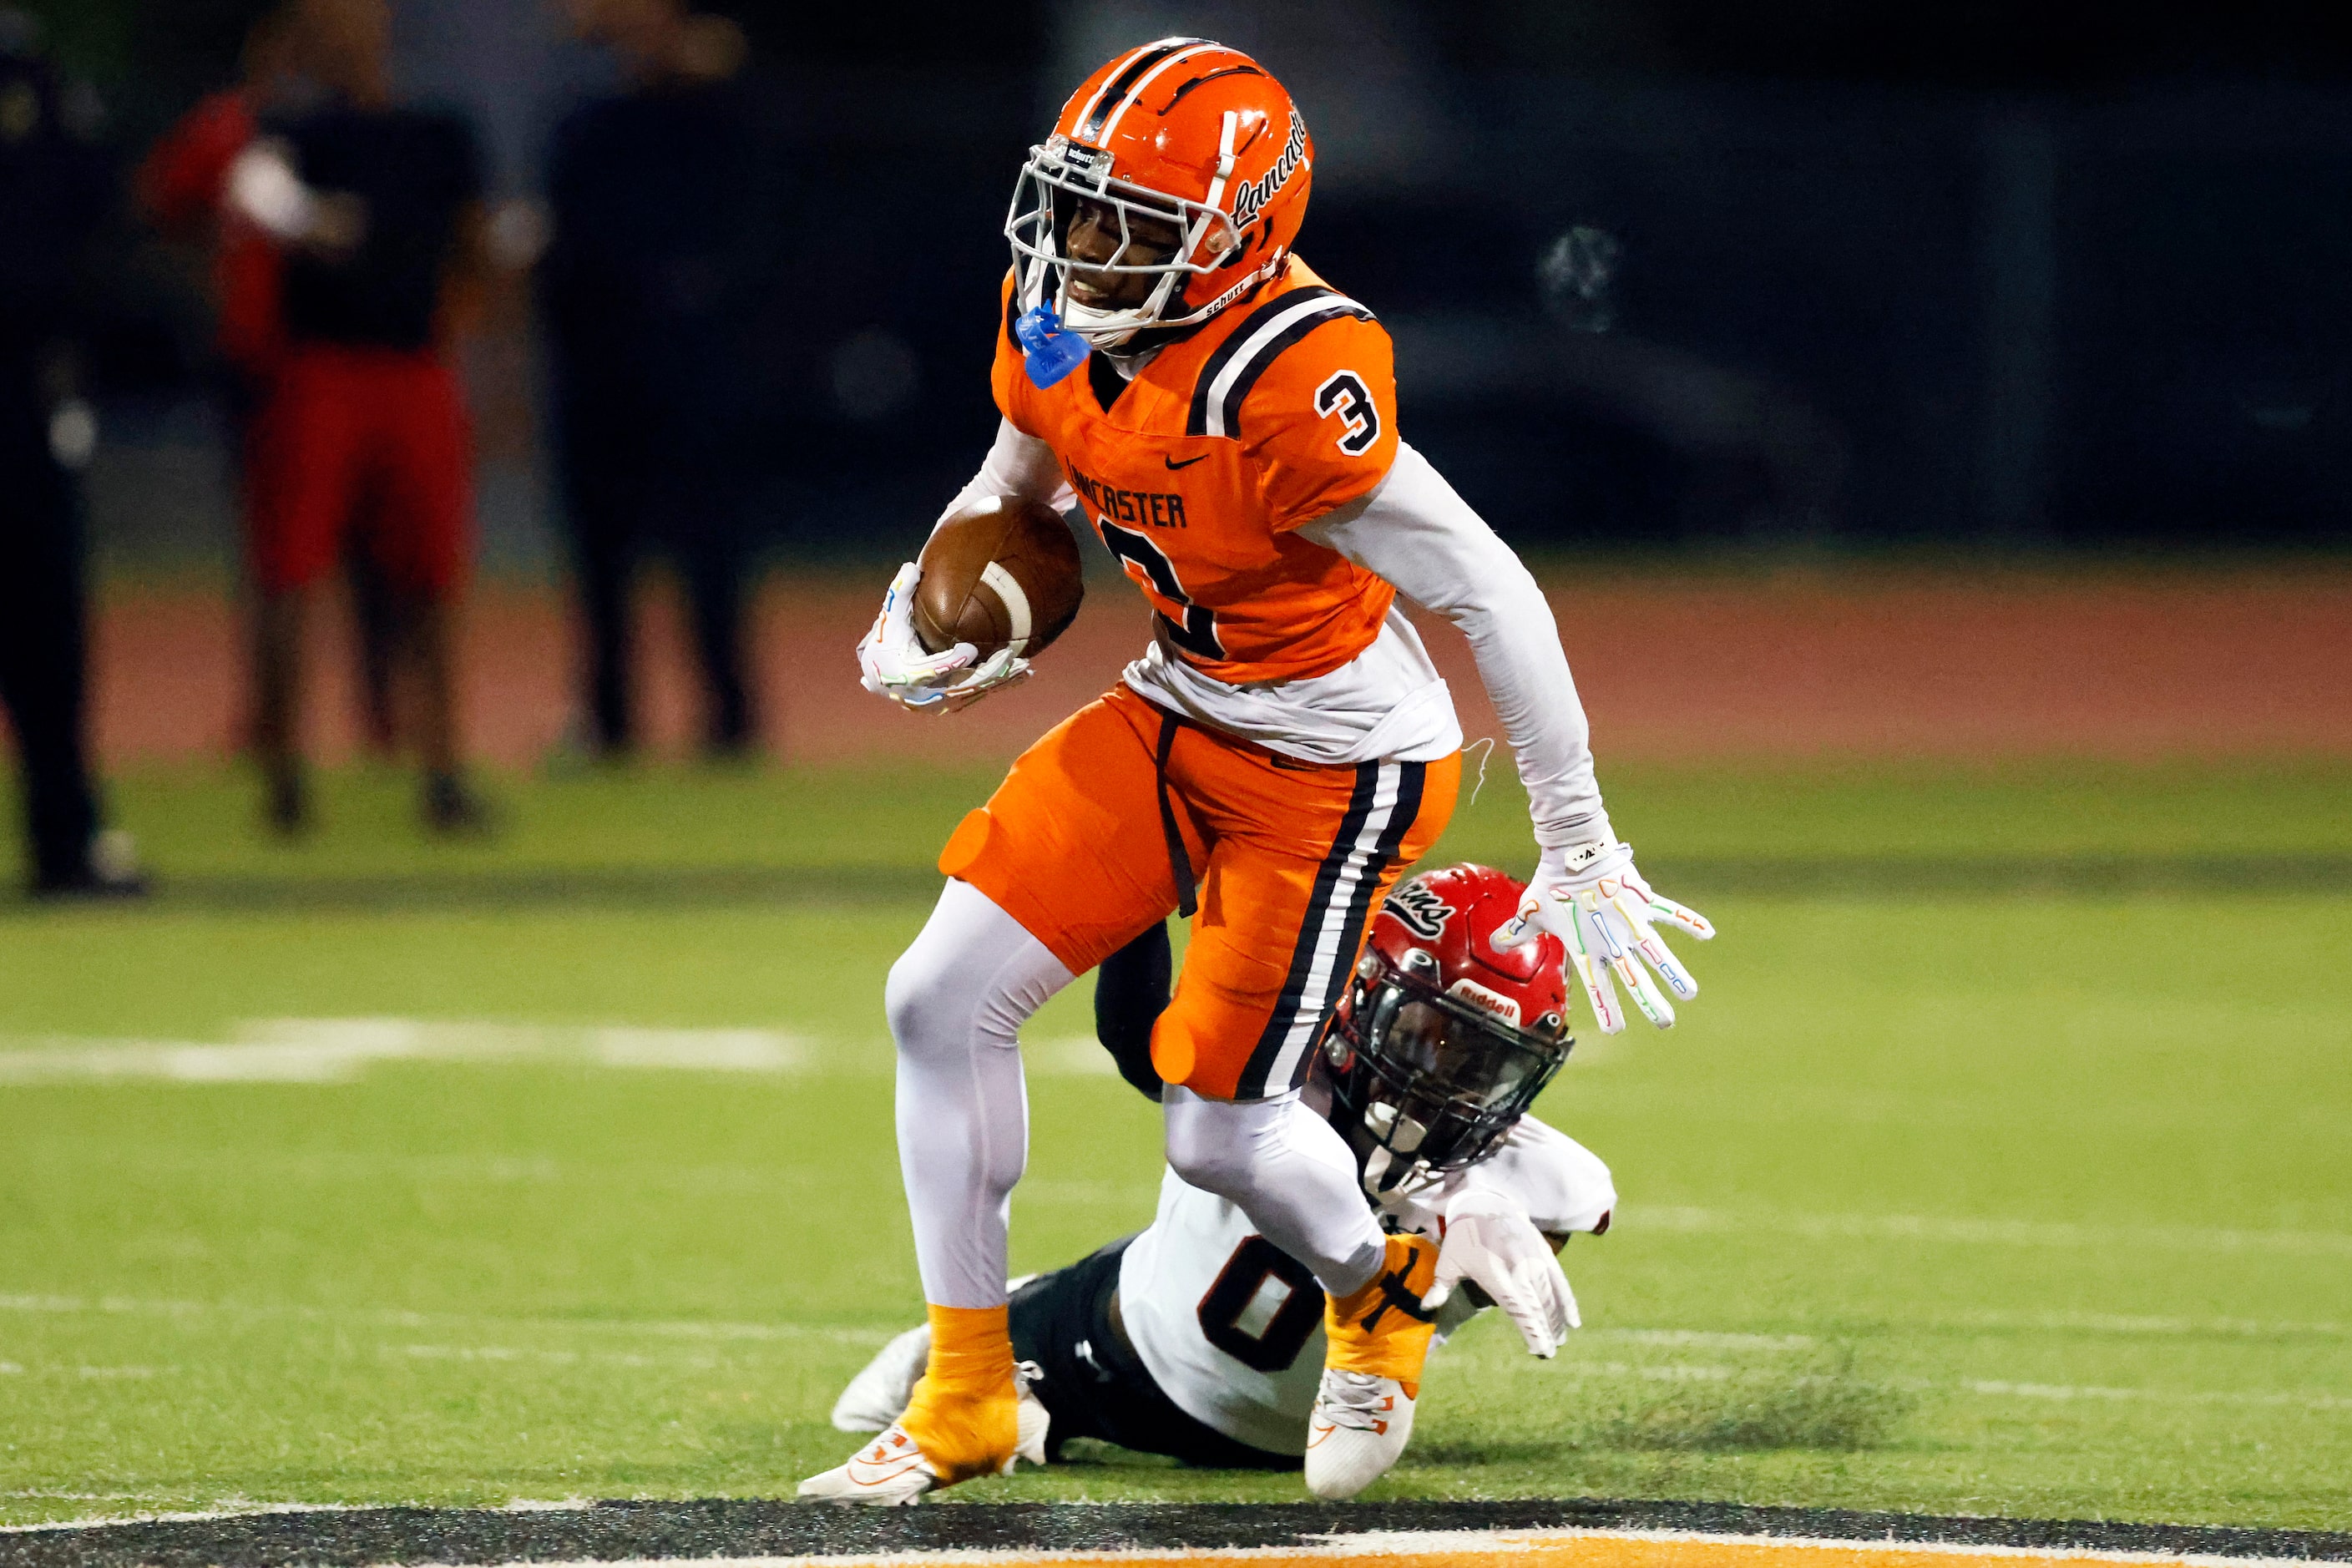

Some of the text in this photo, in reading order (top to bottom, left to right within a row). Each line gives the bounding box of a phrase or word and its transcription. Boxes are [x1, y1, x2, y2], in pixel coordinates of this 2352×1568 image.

[1231, 113, 1306, 230] Lancast
[1206, 282, 1244, 316] schutt
[1314, 369, 1381, 457] 3
[1459, 986, 1515, 1018] Riddell
